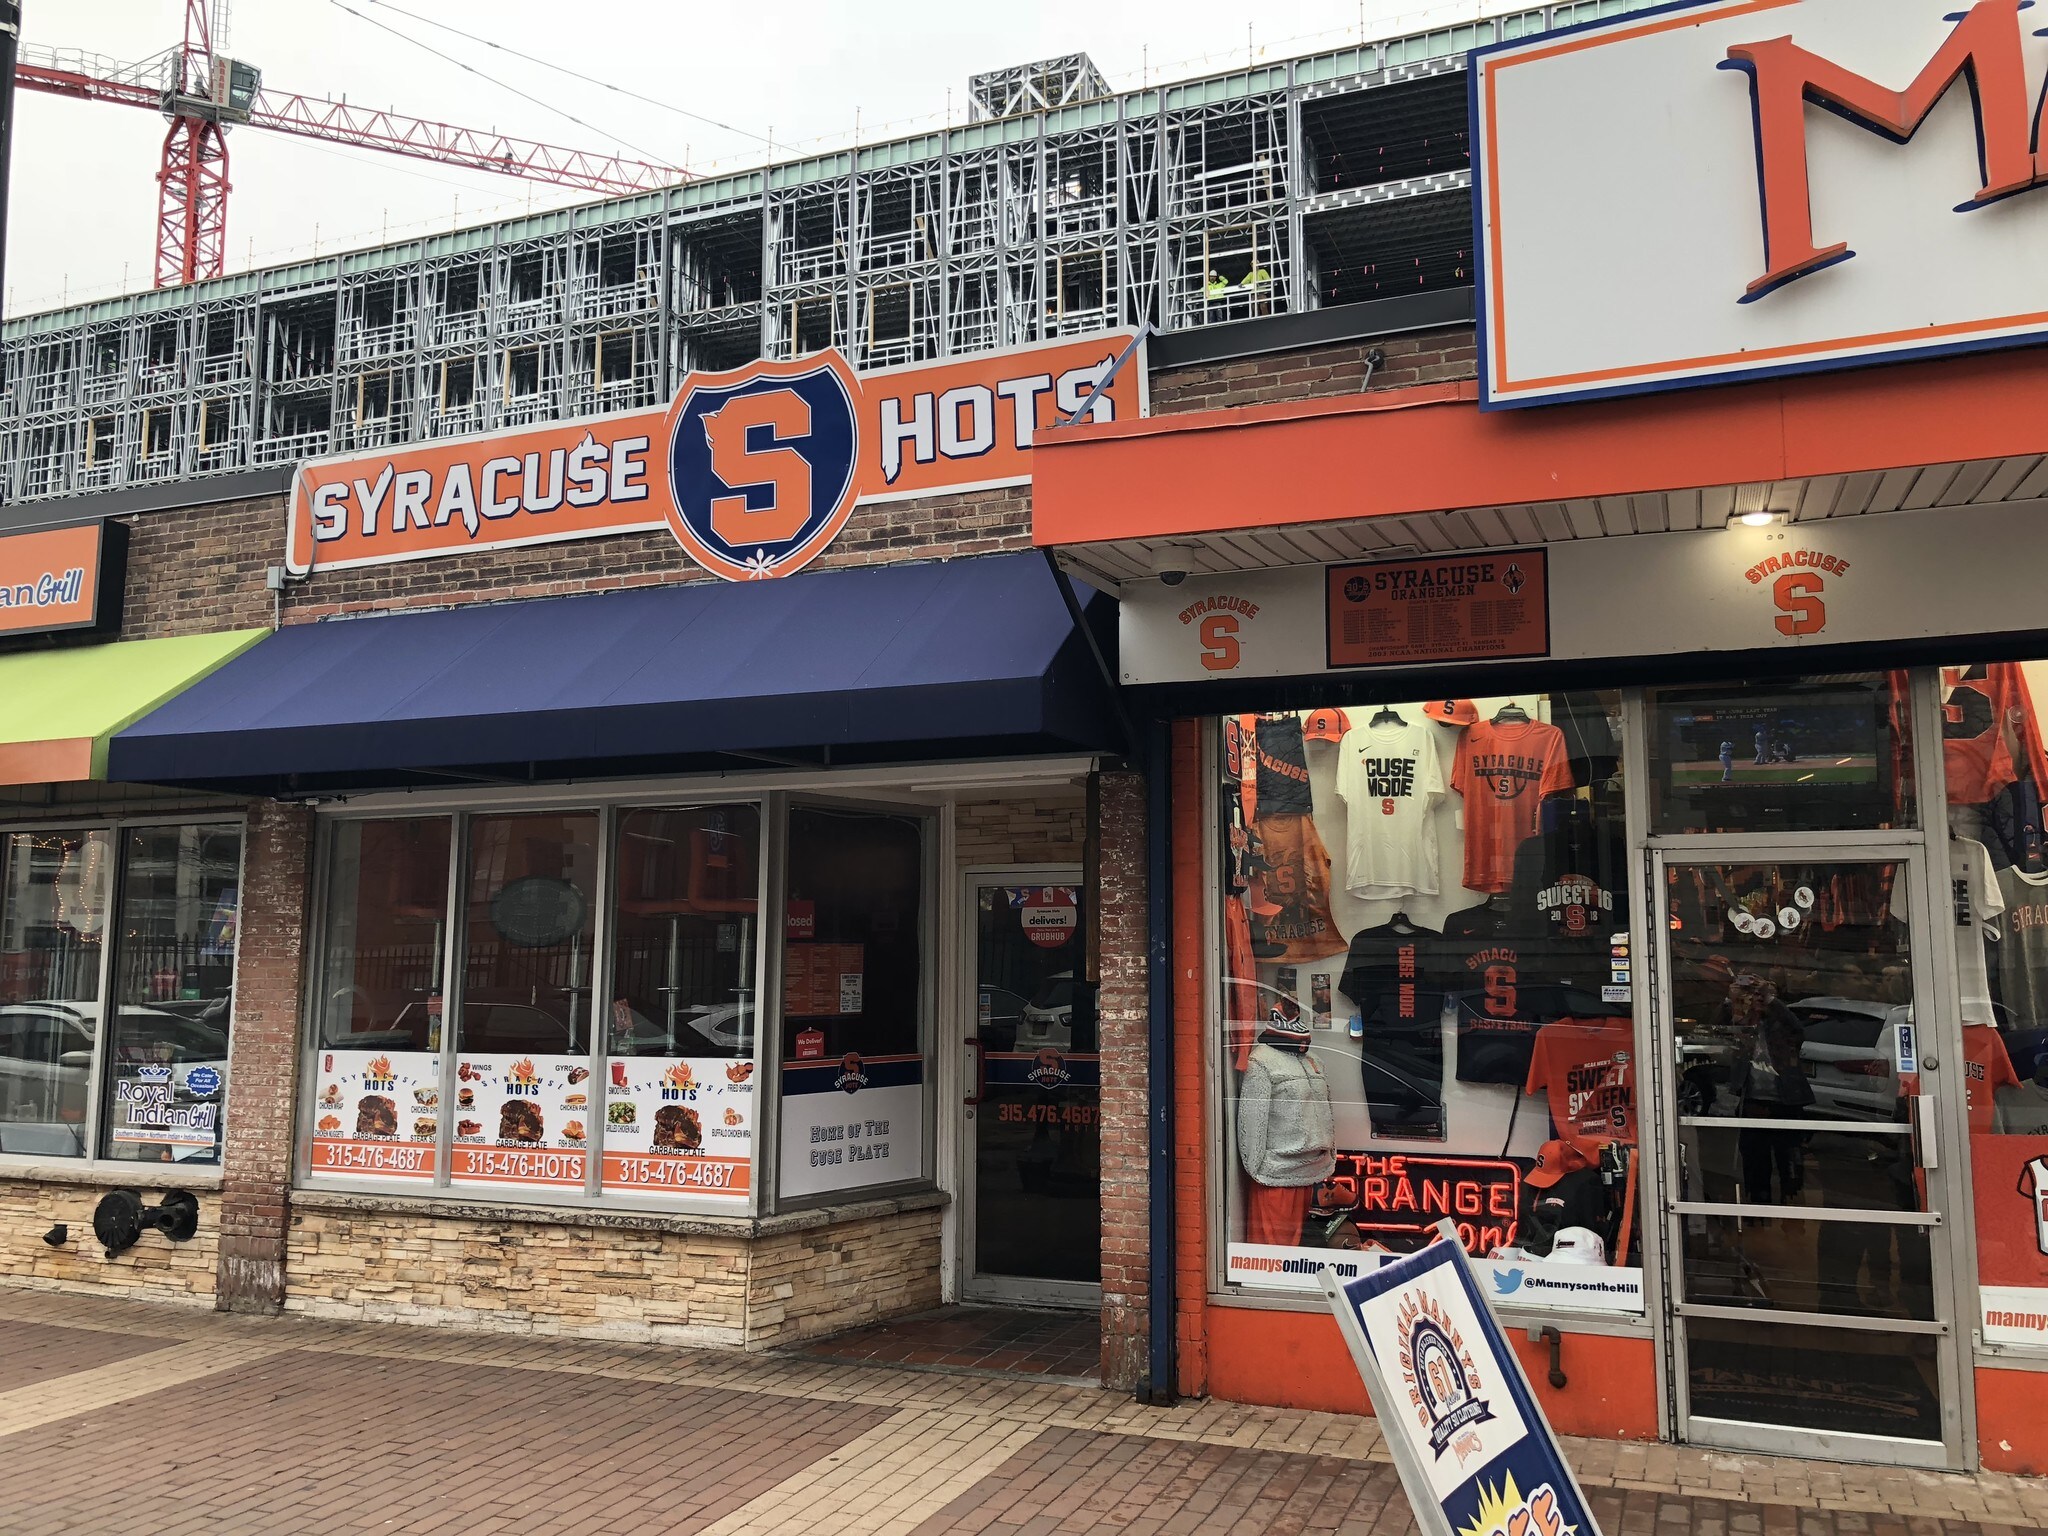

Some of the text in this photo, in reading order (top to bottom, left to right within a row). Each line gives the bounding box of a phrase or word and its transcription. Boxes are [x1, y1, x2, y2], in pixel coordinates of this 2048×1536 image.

[1717, 0, 2048, 304] M
[880, 353, 1116, 484] HOTS
[312, 429, 650, 537] SYRACUSE
[1375, 564, 1495, 591] SYRACUSE
[1744, 550, 1851, 585] SYRACUSE
[1391, 585, 1475, 601] ORANGEMEN
[1178, 596, 1260, 625] SYRACUSE
[1773, 572, 1827, 636] S
[1200, 615, 1240, 671] S
[1415, 647, 1455, 656] NATIONAL
[1457, 644, 1507, 654] CHAMPIONS
[1473, 754, 1544, 772] SYRACUSE
[1537, 885, 1592, 911] SWEET
[1029, 916, 1068, 925] delivers!
[1031, 932, 1066, 941] GRUBHUB
[1399, 983, 1415, 1018] MODE
[1470, 1017, 1532, 1032] BASKETBALL
[1901, 1028, 1909, 1057] PULL
[364, 1079, 395, 1091] HOTS
[834, 1072, 868, 1089] SYRACUSE
[1028, 1067, 1071, 1082] SYRACUSE
[118, 1080, 174, 1106] Royal
[507, 1083, 539, 1096] HOTS
[662, 1088, 697, 1101] HOTS
[411, 1105, 429, 1113] CHICKEN
[999, 1103, 1100, 1124] 315.476.4687
[353, 1132, 400, 1143] GARBAGE PLATE
[496, 1139, 548, 1150] GARBAGE PLATE
[327, 1145, 425, 1170] 315-476-4687
[649, 1145, 706, 1158] GARBAGE PLATE
[848, 1142, 890, 1162] PLATE
[467, 1152, 582, 1180] 315-476-HOTS
[620, 1159, 735, 1187] 315-476-4687
[1350, 1155, 1408, 1175] THE
[1231, 1255, 1358, 1277] mannysonlineom
[1524, 1277, 1640, 1295] @MannysontheHill
[1428, 1355, 1455, 1402] 61
[1432, 1416, 1455, 1445] QUALITY
